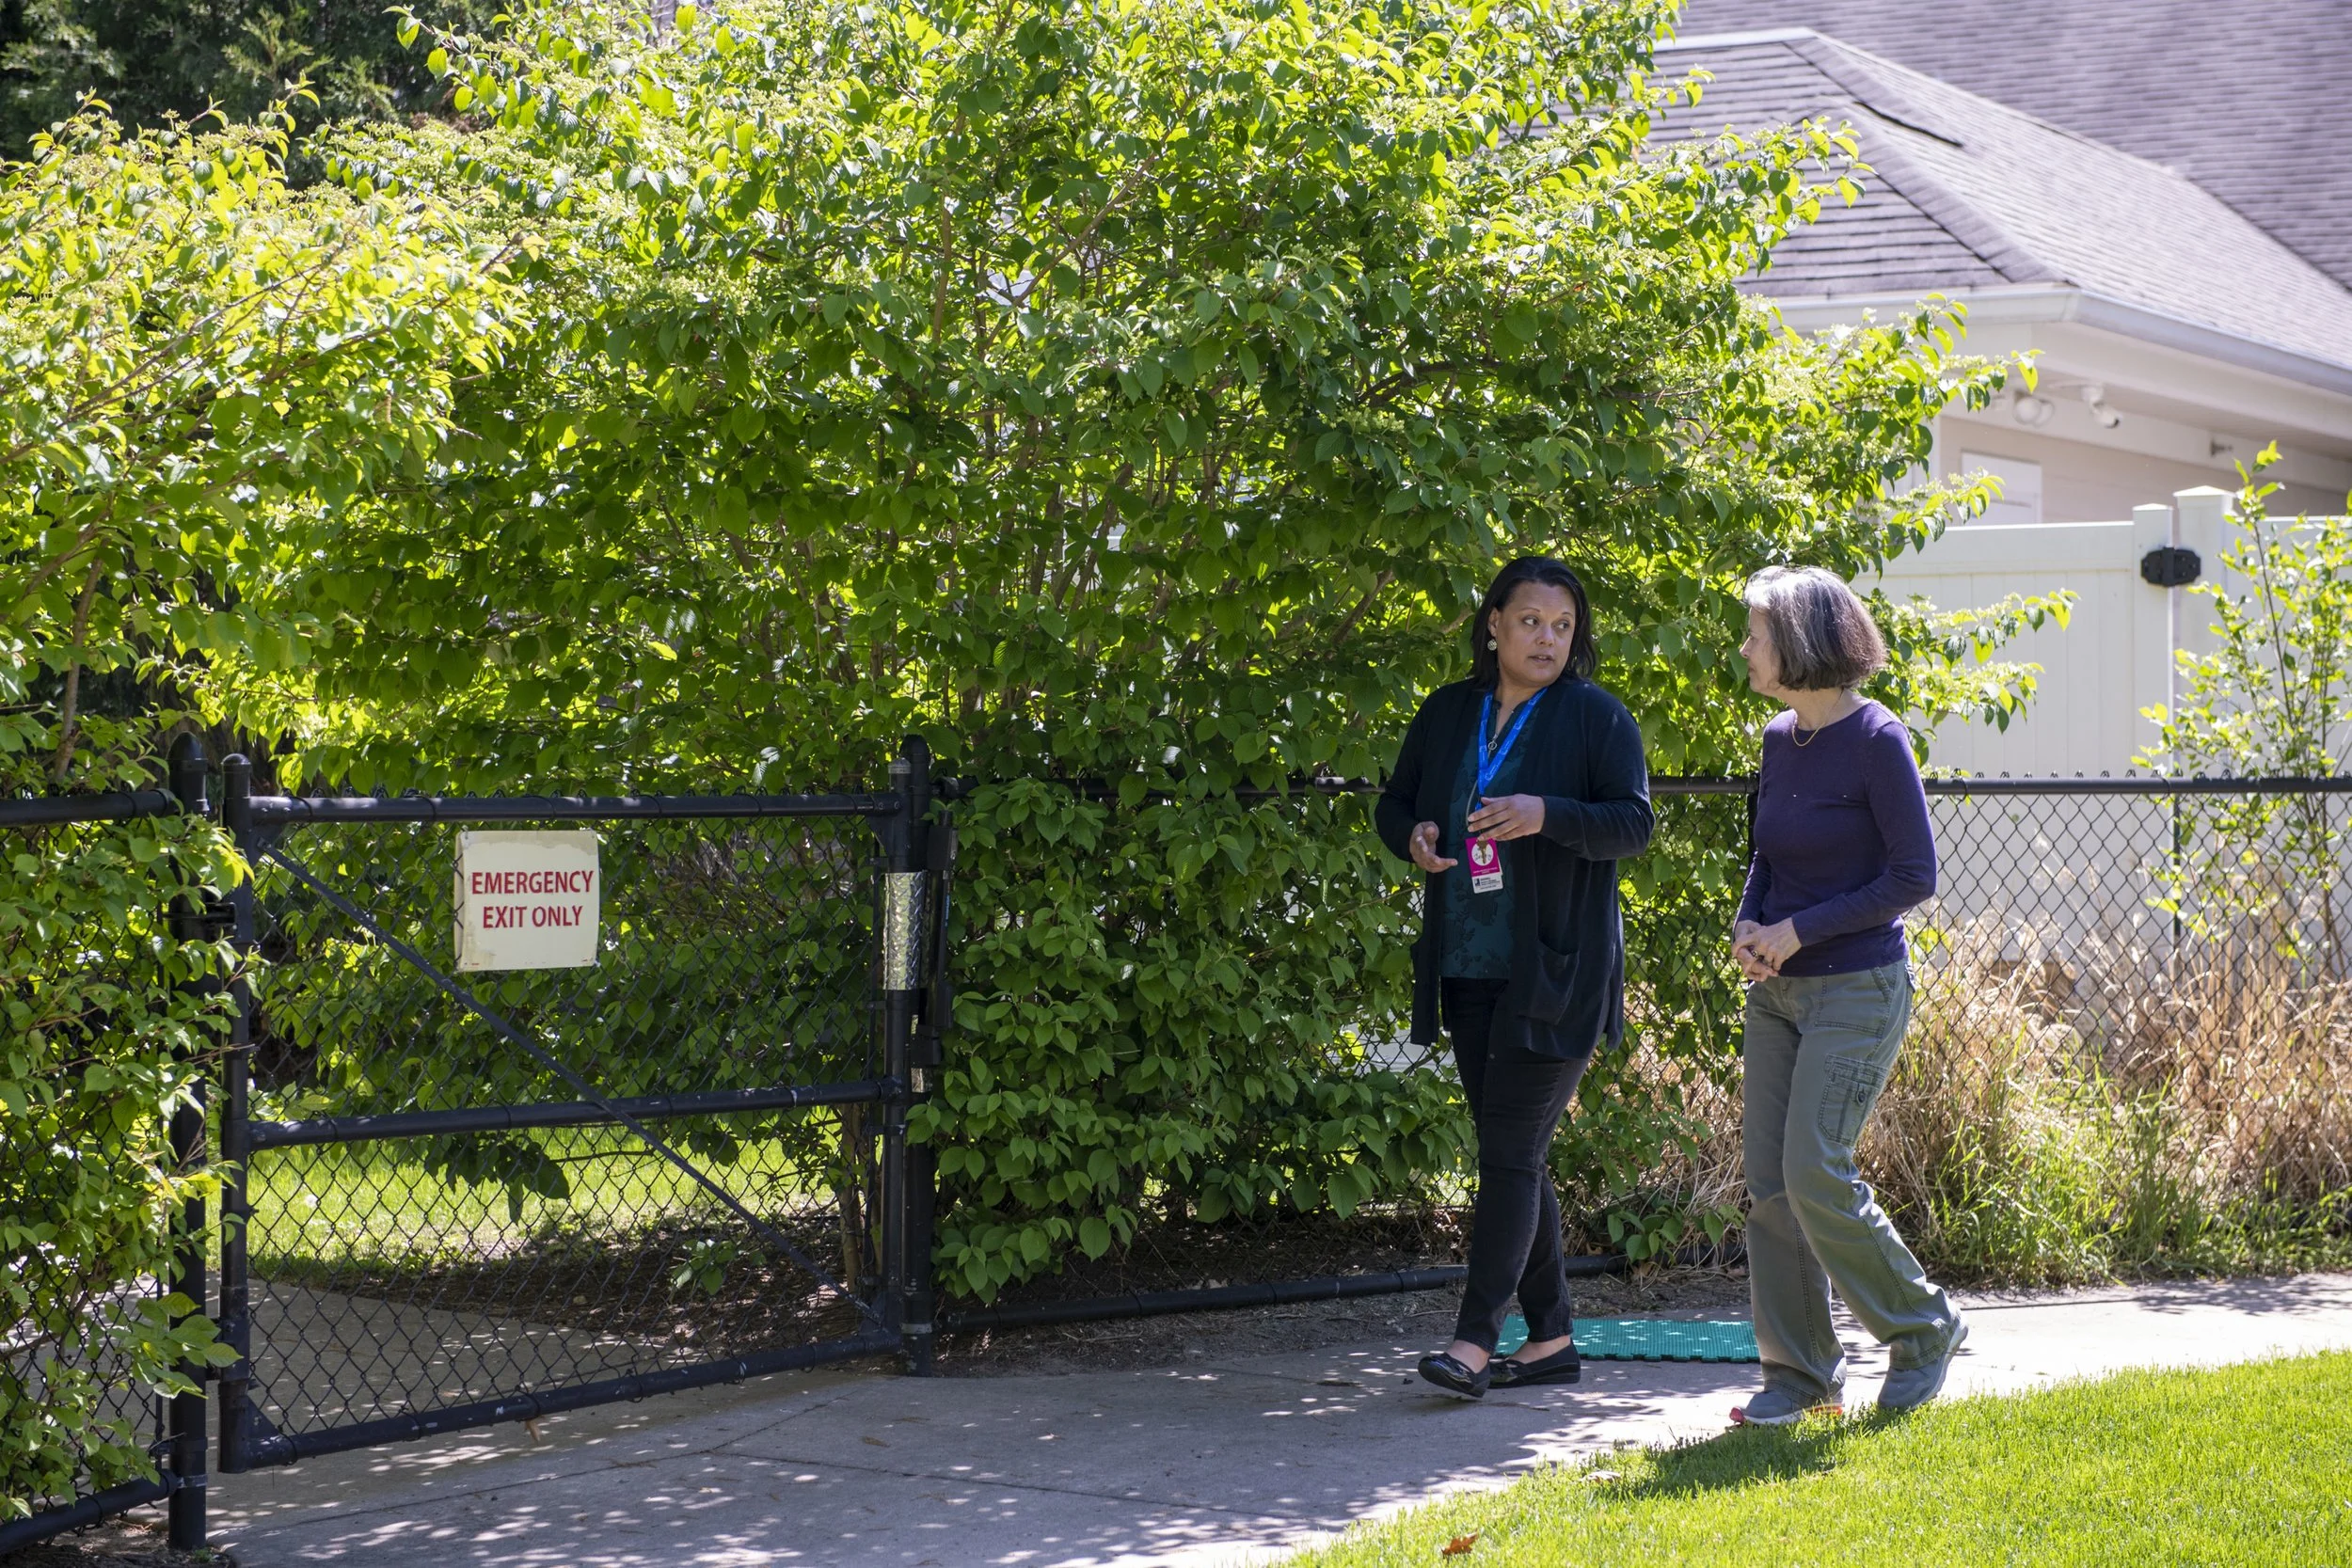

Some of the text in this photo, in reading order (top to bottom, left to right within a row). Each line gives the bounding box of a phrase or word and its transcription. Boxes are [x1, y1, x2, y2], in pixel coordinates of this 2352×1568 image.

[471, 870, 594, 895] EMERGENCY
[483, 905, 583, 928] EXIT ONLY
